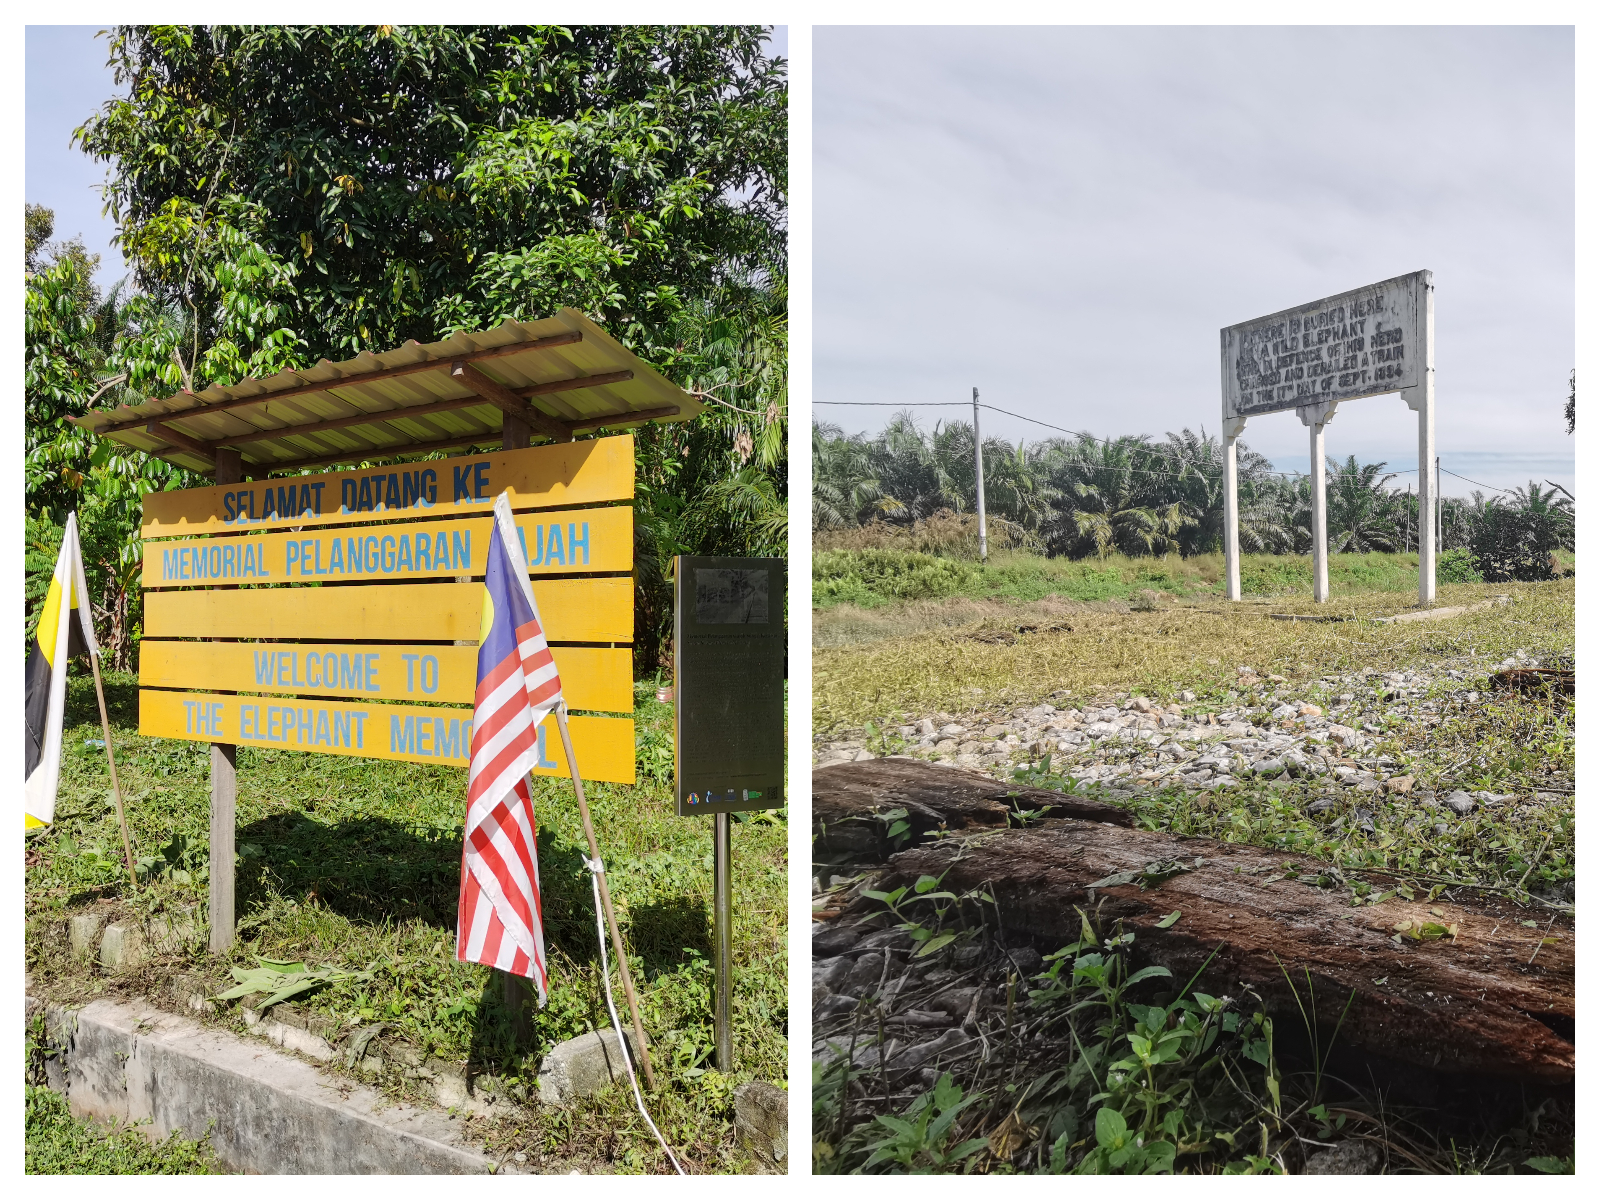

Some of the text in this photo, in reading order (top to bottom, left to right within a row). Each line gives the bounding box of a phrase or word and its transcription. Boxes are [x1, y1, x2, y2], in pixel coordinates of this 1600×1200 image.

[1303, 319, 1366, 349] ELEPHANT
[1304, 307, 1345, 333] BURIED
[1327, 343, 1341, 359] OF
[1344, 337, 1364, 355] HIS
[1371, 327, 1403, 349] HERD
[1285, 366, 1304, 383] AND
[1307, 355, 1358, 377] DERAILED
[1362, 354, 1369, 367] A
[1372, 344, 1404, 365] TRAIN
[1256, 386, 1274, 403] THE
[1297, 379, 1316, 396] DAY
[1320, 375, 1335, 391] OF
[223, 461, 491, 526] SELAMAT DATANG KE
[163, 542, 269, 581] MEMORIAL
[286, 530, 471, 577] PELANGGARAN
[253, 650, 439, 694] WELCOME TO
[183, 701, 224, 737] THE
[240, 705, 369, 749] ELEPHANT
